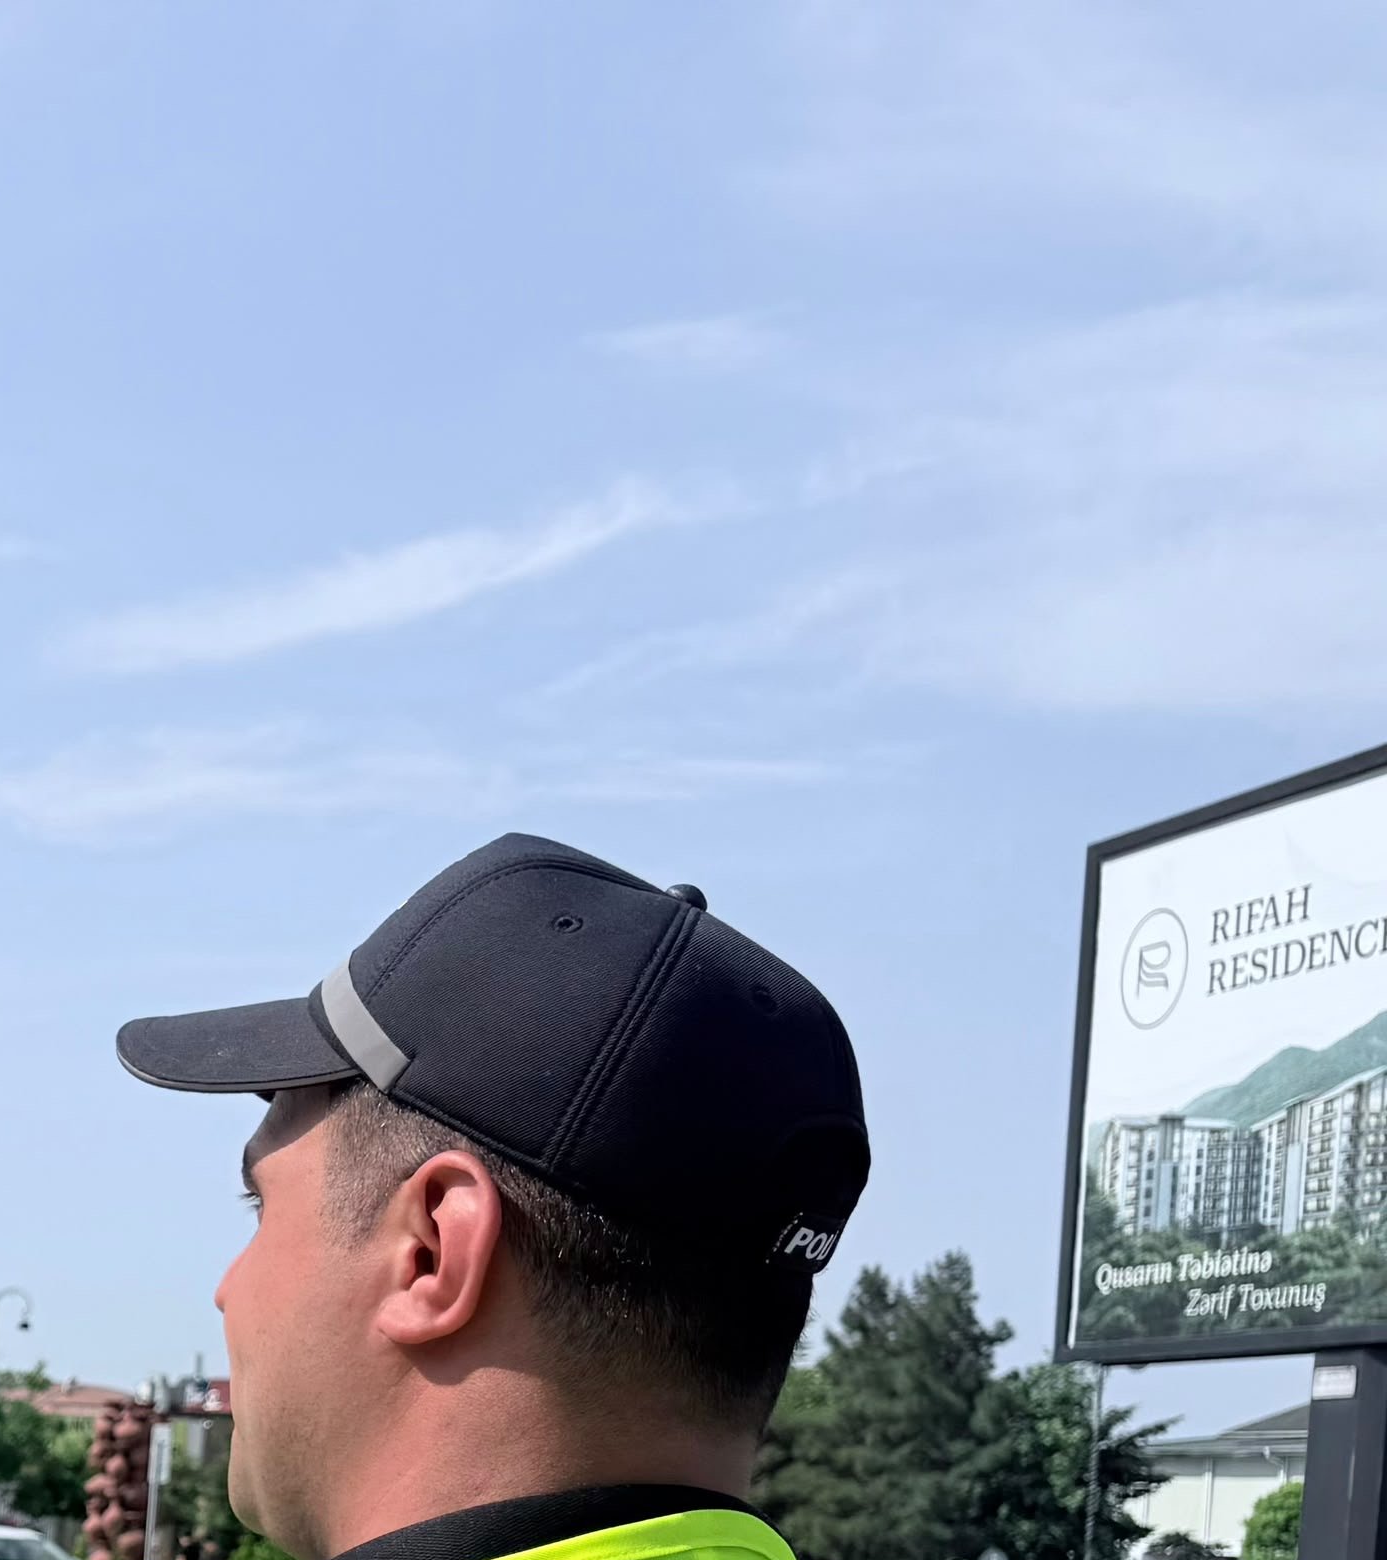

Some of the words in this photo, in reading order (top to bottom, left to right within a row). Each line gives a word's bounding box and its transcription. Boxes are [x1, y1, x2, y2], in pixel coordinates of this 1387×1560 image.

[1210, 883, 1313, 947] RIFAH
[1183, 1283, 1237, 1321] Zərif
[1237, 1281, 1328, 1314] Toxunuş
